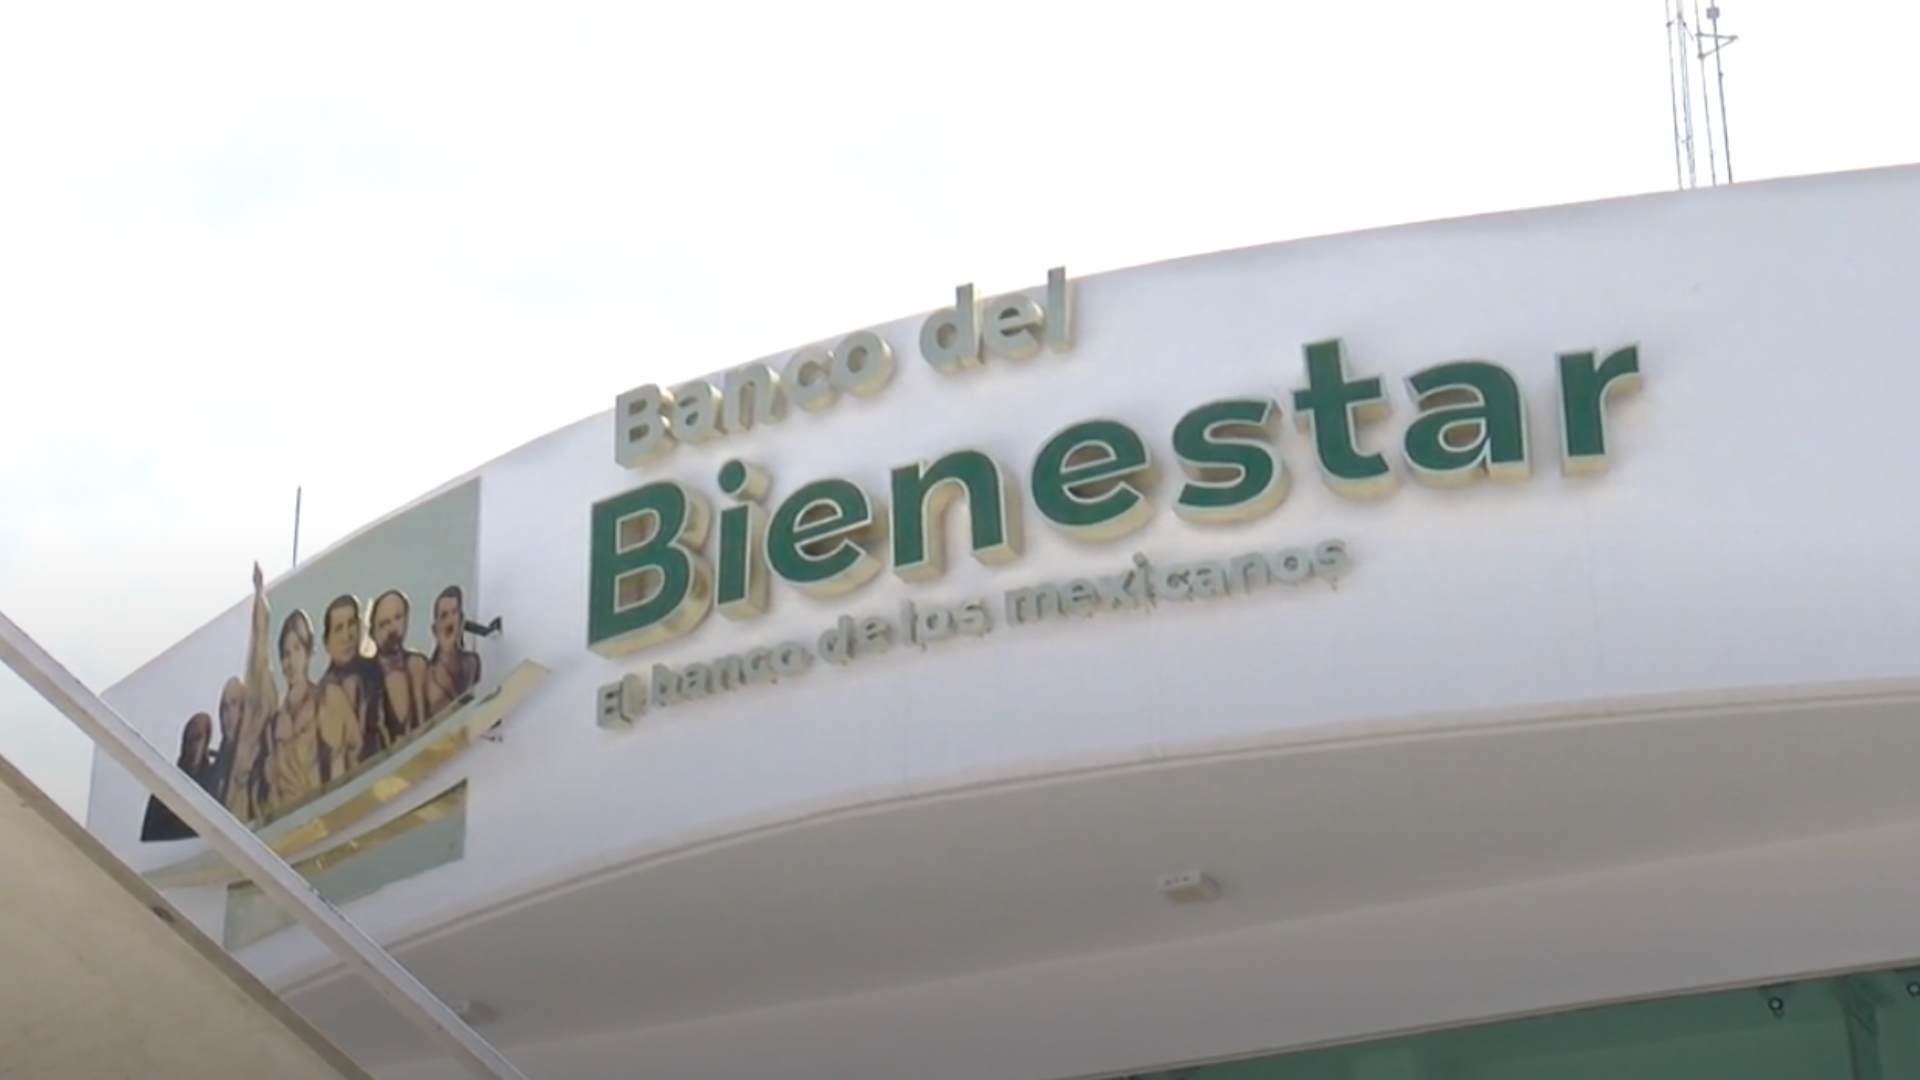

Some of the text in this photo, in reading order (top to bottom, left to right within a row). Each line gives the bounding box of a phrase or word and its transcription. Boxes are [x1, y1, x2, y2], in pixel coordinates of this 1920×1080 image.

[615, 266, 1075, 467] Banco del
[589, 339, 1640, 655] Bienestar
[597, 540, 1350, 728] El banco de los mexicanos
